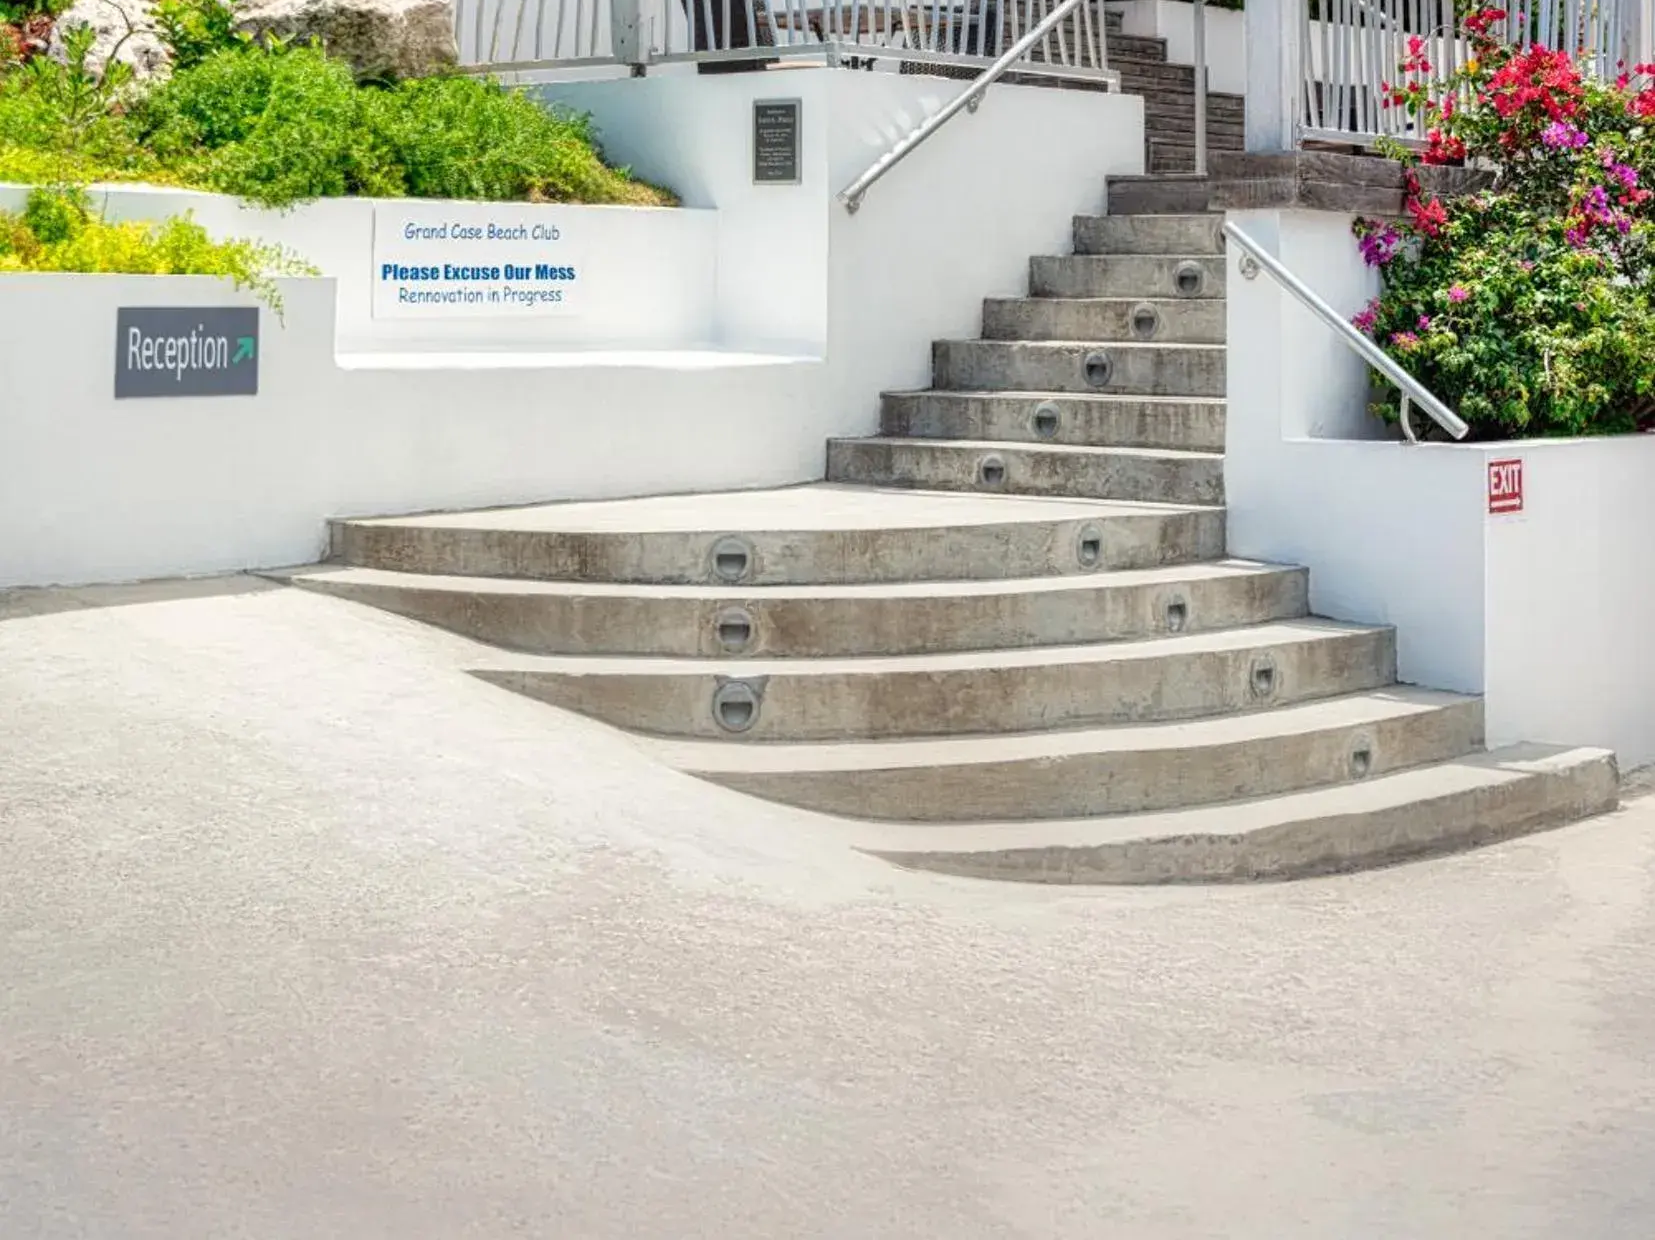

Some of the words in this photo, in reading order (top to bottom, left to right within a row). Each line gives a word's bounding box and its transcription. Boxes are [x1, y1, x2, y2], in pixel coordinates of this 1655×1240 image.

[404, 222, 447, 240] Grand
[451, 223, 483, 240] Case
[487, 223, 528, 241] Beach
[532, 224, 561, 241] Club
[382, 263, 440, 281] Please
[444, 263, 500, 281] Excuse
[504, 263, 532, 281] Our
[535, 263, 576, 281] Mess
[399, 287, 484, 304] Rennovation
[488, 287, 501, 303] in
[503, 286, 563, 307] Progress
[127, 323, 229, 382] Reception
[1490, 463, 1521, 495] EXIT
